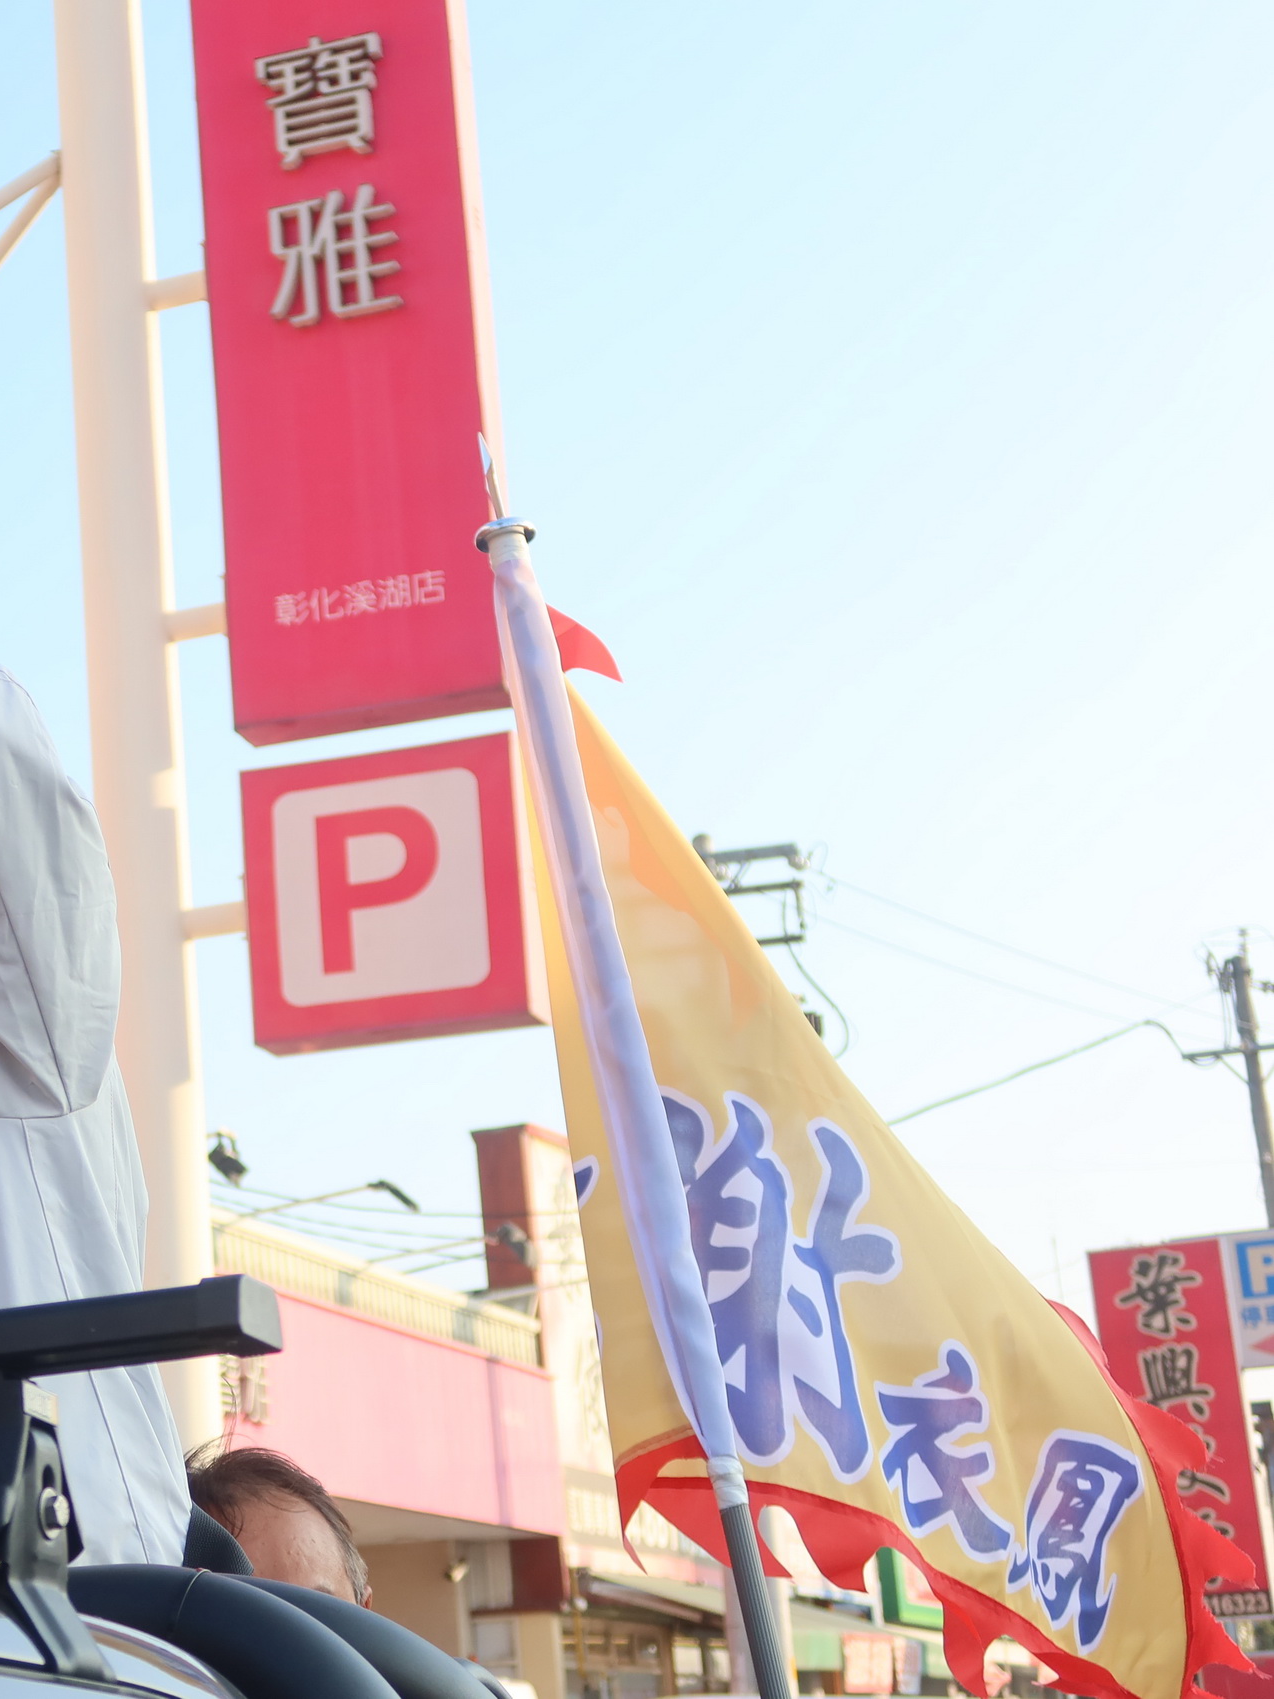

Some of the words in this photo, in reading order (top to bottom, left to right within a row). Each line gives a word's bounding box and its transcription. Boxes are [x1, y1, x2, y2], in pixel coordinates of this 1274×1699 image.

[254, 30, 404, 329] 寶雅
[274, 569, 446, 626] 彰化溪湖店
[314, 804, 441, 976] P
